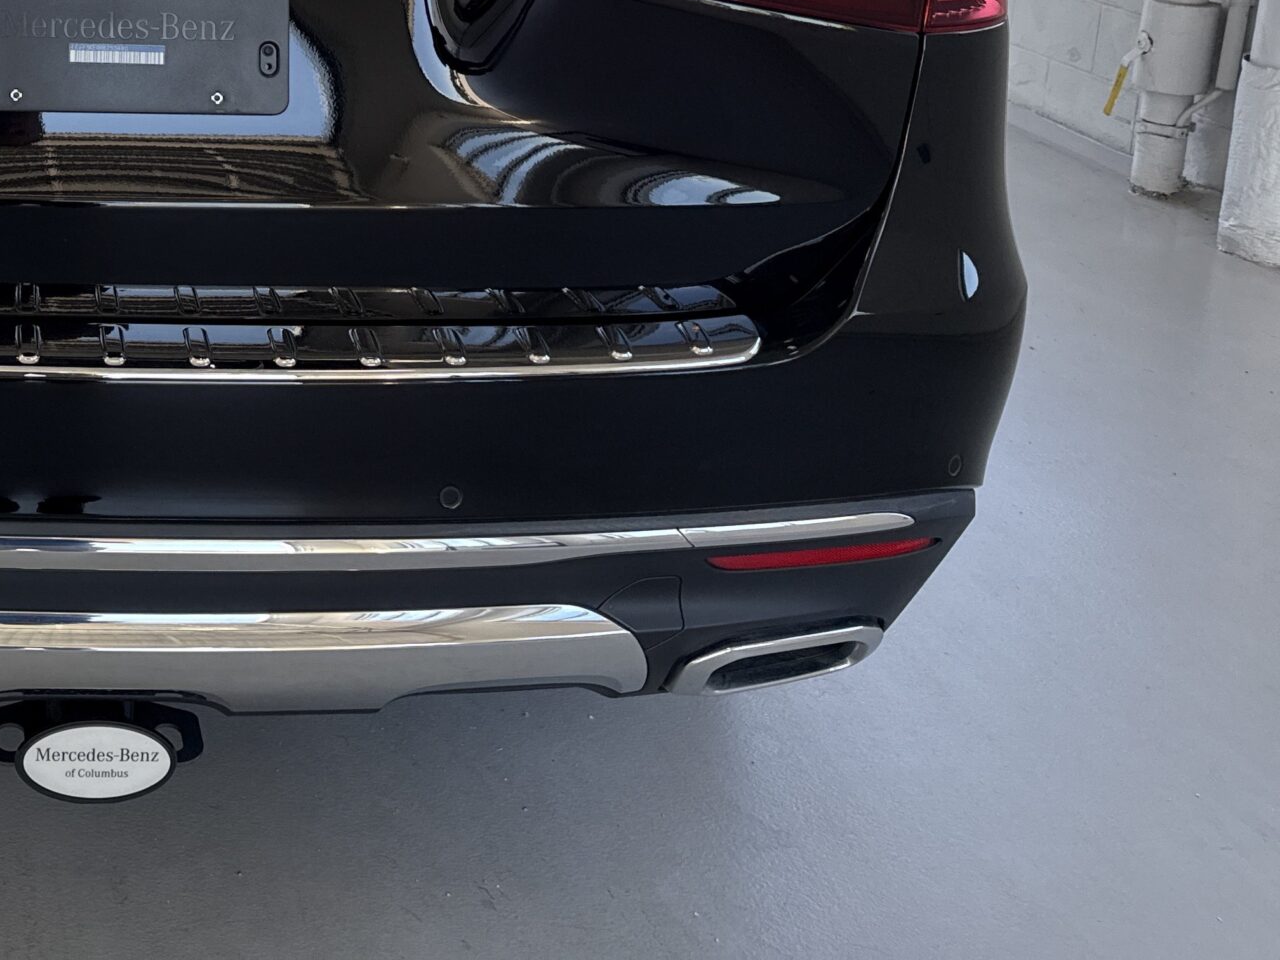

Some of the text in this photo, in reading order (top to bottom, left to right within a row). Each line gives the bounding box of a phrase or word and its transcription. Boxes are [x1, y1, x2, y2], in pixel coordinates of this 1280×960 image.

[1, 12, 236, 41] Mercedes-Benz
[35, 747, 160, 762] Mercedes-Benz
[65, 768, 129, 778] of Columbus
